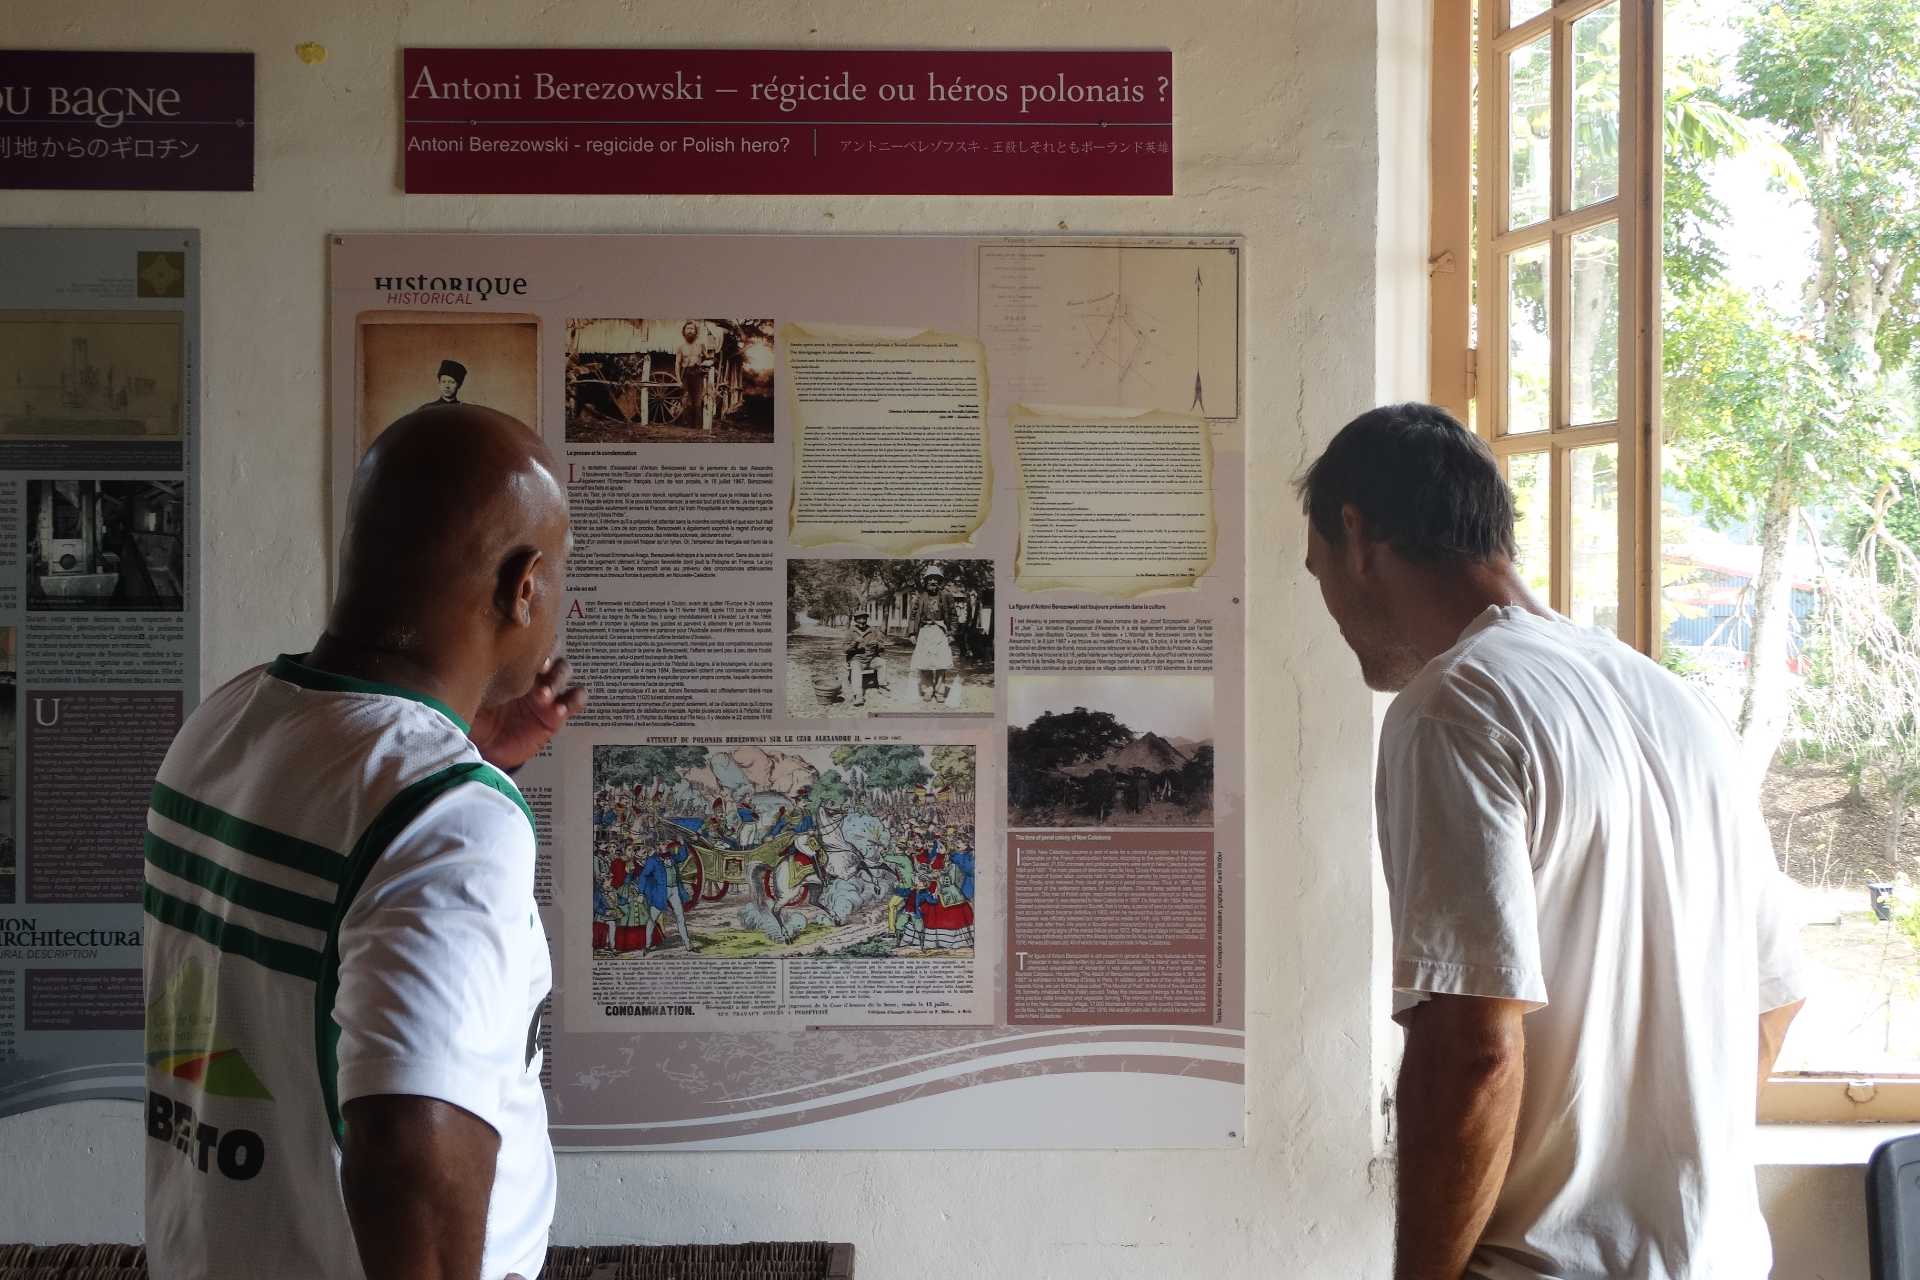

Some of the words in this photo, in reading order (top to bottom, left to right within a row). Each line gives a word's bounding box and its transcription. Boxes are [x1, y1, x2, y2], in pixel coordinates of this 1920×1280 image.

[407, 65, 523, 101] Antoni
[534, 71, 704, 101] Berezowski
[750, 71, 867, 112] régicide
[879, 82, 915, 102] ou
[928, 72, 1008, 102] héros
[1019, 73, 1144, 113] polonais
[1157, 76, 1169, 102] ?
[0, 86, 33, 115] U
[407, 136, 464, 154] Antoni
[469, 136, 568, 154] Berezowski
[586, 136, 653, 156] regicide
[659, 141, 678, 154] or
[683, 136, 735, 154] Polish
[741, 136, 790, 154] hero?
[386, 292, 473, 305] HISTORICAL
[605, 1005, 697, 1017] CONDAMNATION.
